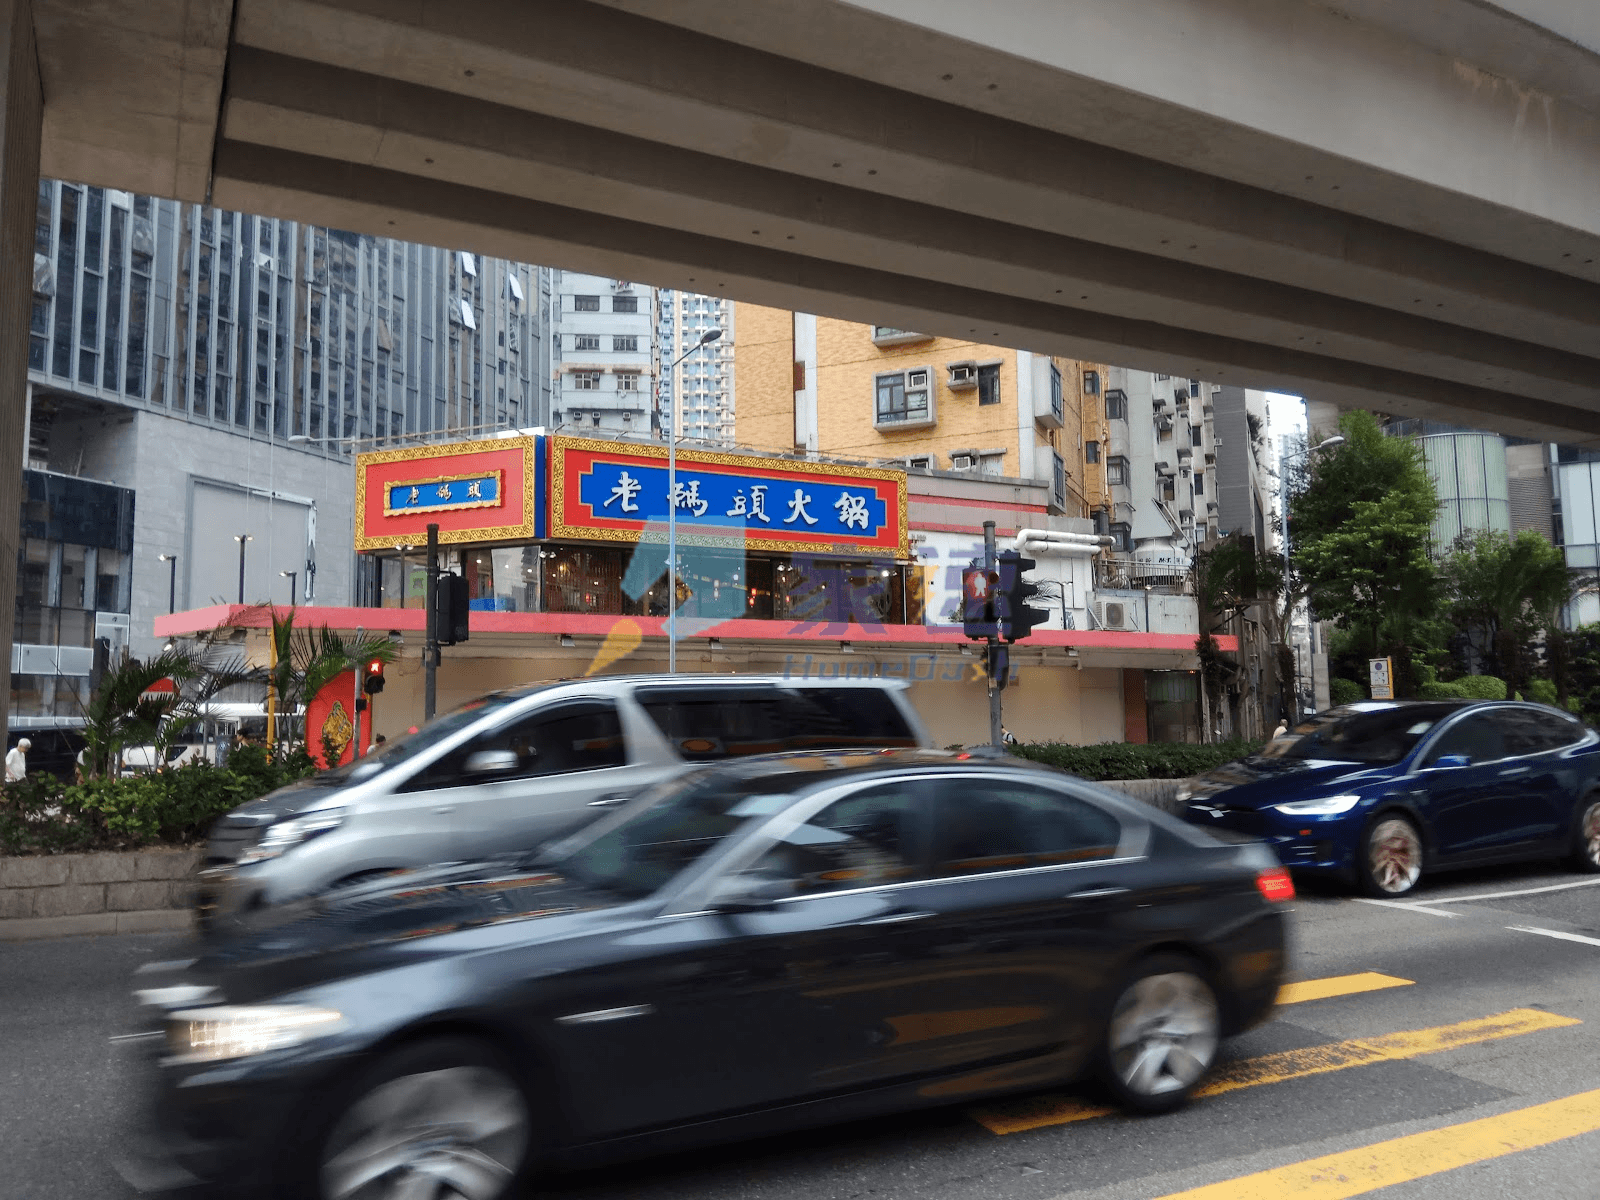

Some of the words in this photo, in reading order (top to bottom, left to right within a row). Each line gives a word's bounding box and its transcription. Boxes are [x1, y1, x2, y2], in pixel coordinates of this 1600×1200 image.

[603, 471, 869, 529] 老碼頭火鍋
